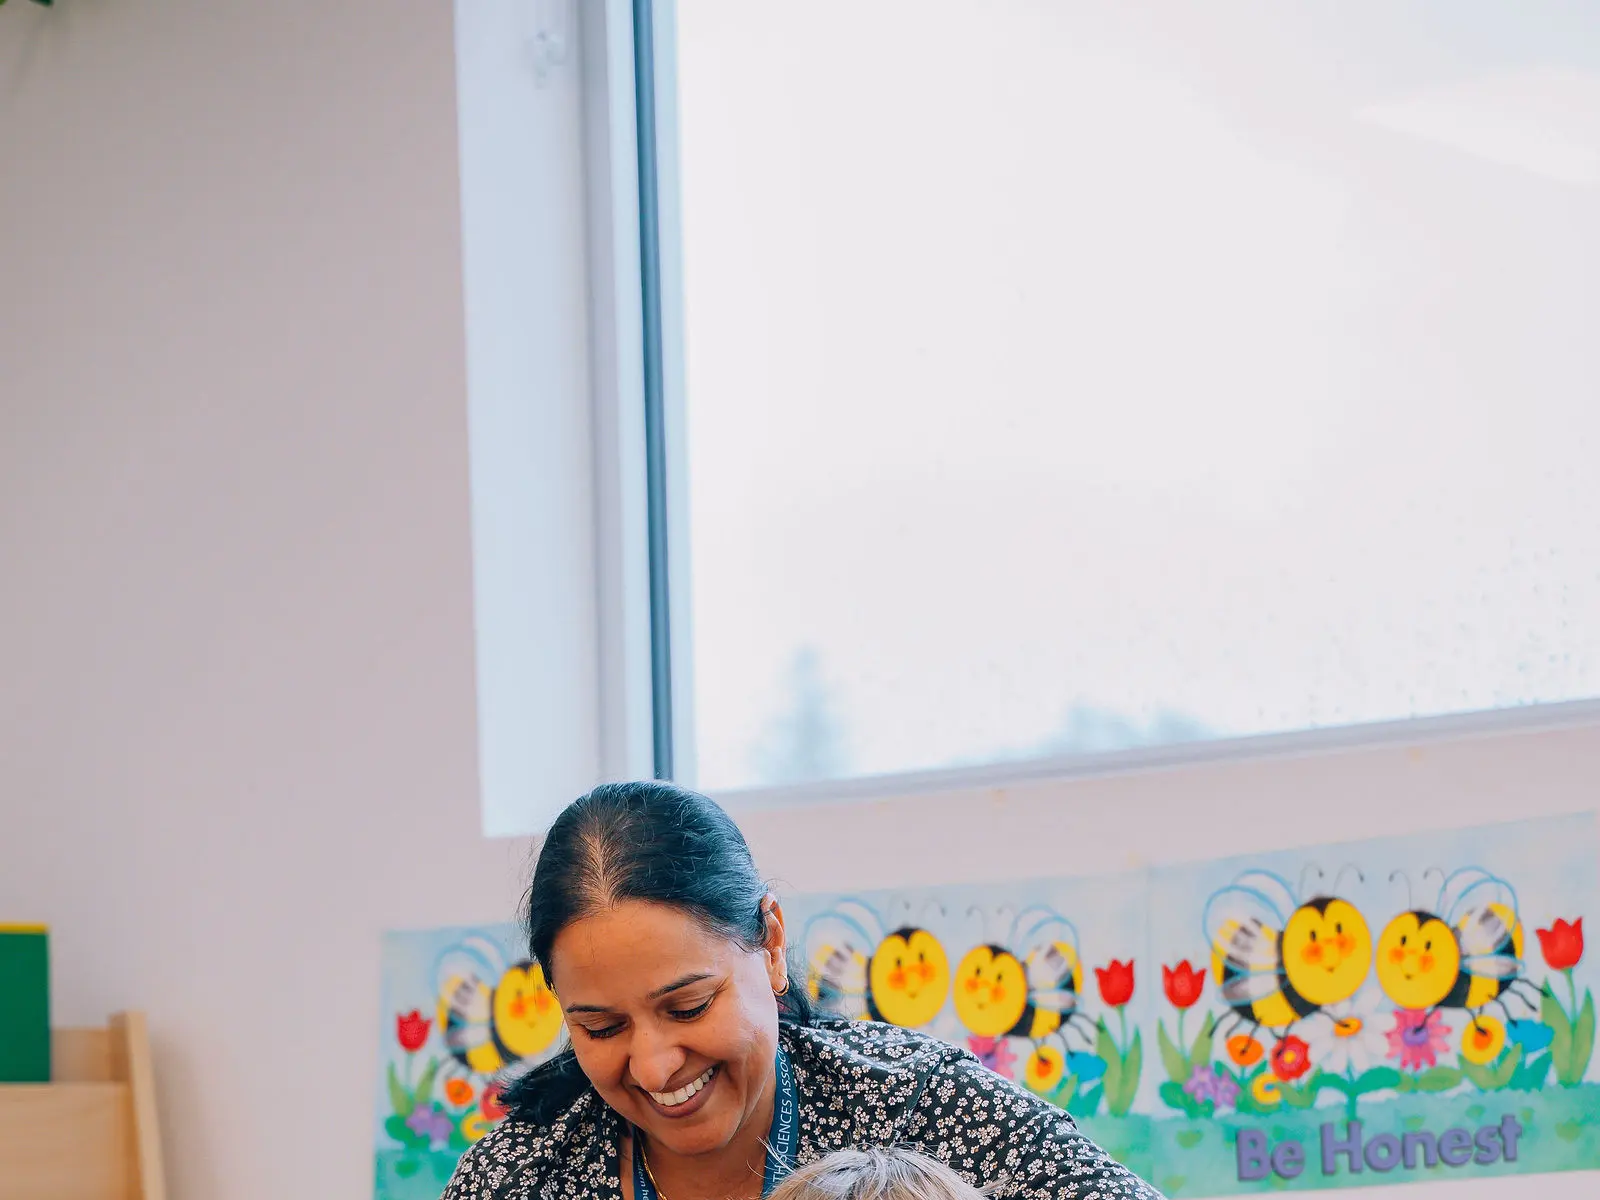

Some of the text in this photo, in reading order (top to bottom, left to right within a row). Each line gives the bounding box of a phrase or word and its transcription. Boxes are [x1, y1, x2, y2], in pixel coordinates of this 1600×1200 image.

[776, 1099, 793, 1162] SCIENCES
[1236, 1113, 1523, 1182] Be Honest
